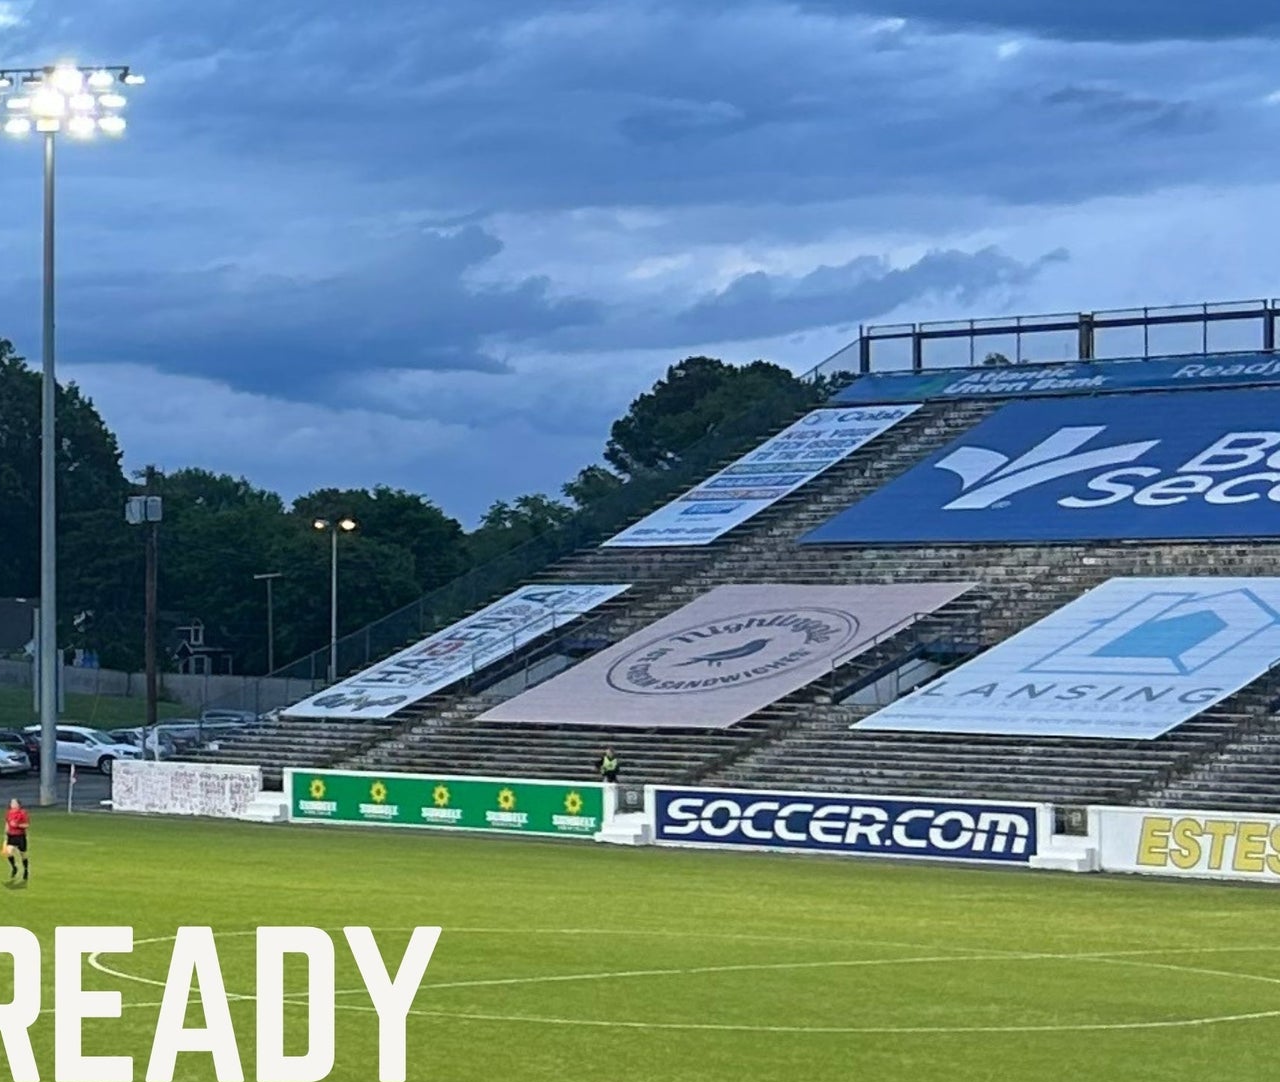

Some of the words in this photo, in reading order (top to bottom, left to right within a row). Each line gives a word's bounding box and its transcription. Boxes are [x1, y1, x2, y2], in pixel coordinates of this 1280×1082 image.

[943, 381, 1029, 394] Union
[1029, 375, 1113, 391] Bank
[957, 367, 1076, 383] Atlantic
[920, 681, 1225, 705] LANSING
[662, 798, 1032, 855] SOCCER.COM
